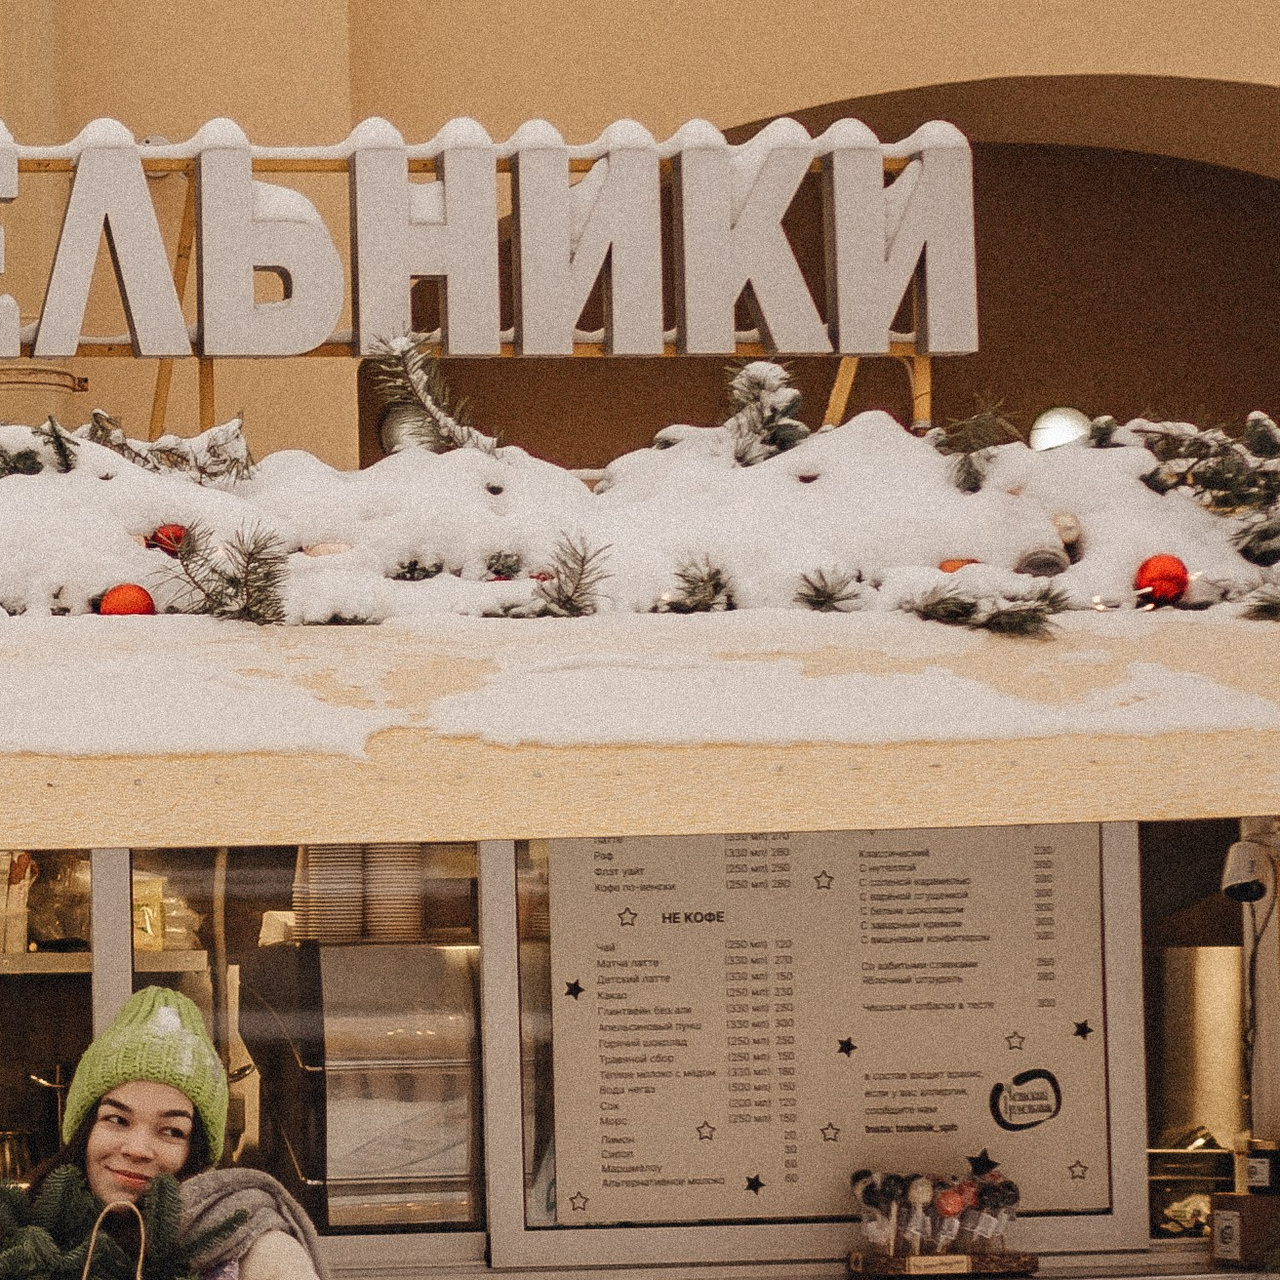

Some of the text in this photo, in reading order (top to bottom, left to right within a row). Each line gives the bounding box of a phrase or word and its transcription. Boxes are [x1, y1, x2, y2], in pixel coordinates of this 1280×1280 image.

[594, 884, 620, 894] Кофе
[661, 911, 725, 924] НЕ КОФЕ
[594, 942, 616, 952] Чай
[596, 974, 640, 986] Детский
[597, 991, 628, 1000] Какао
[599, 1022, 673, 1032] Апельсиновый
[649, 1053, 675, 1064] сбор
[599, 1085, 625, 1096] Вода
[599, 1101, 619, 1111] Сок
[599, 1116, 628, 1127] Морс
[601, 1135, 636, 1145] Лимон
[601, 1149, 635, 1160] Сироп
[602, 1177, 686, 1188] Альтернативное
